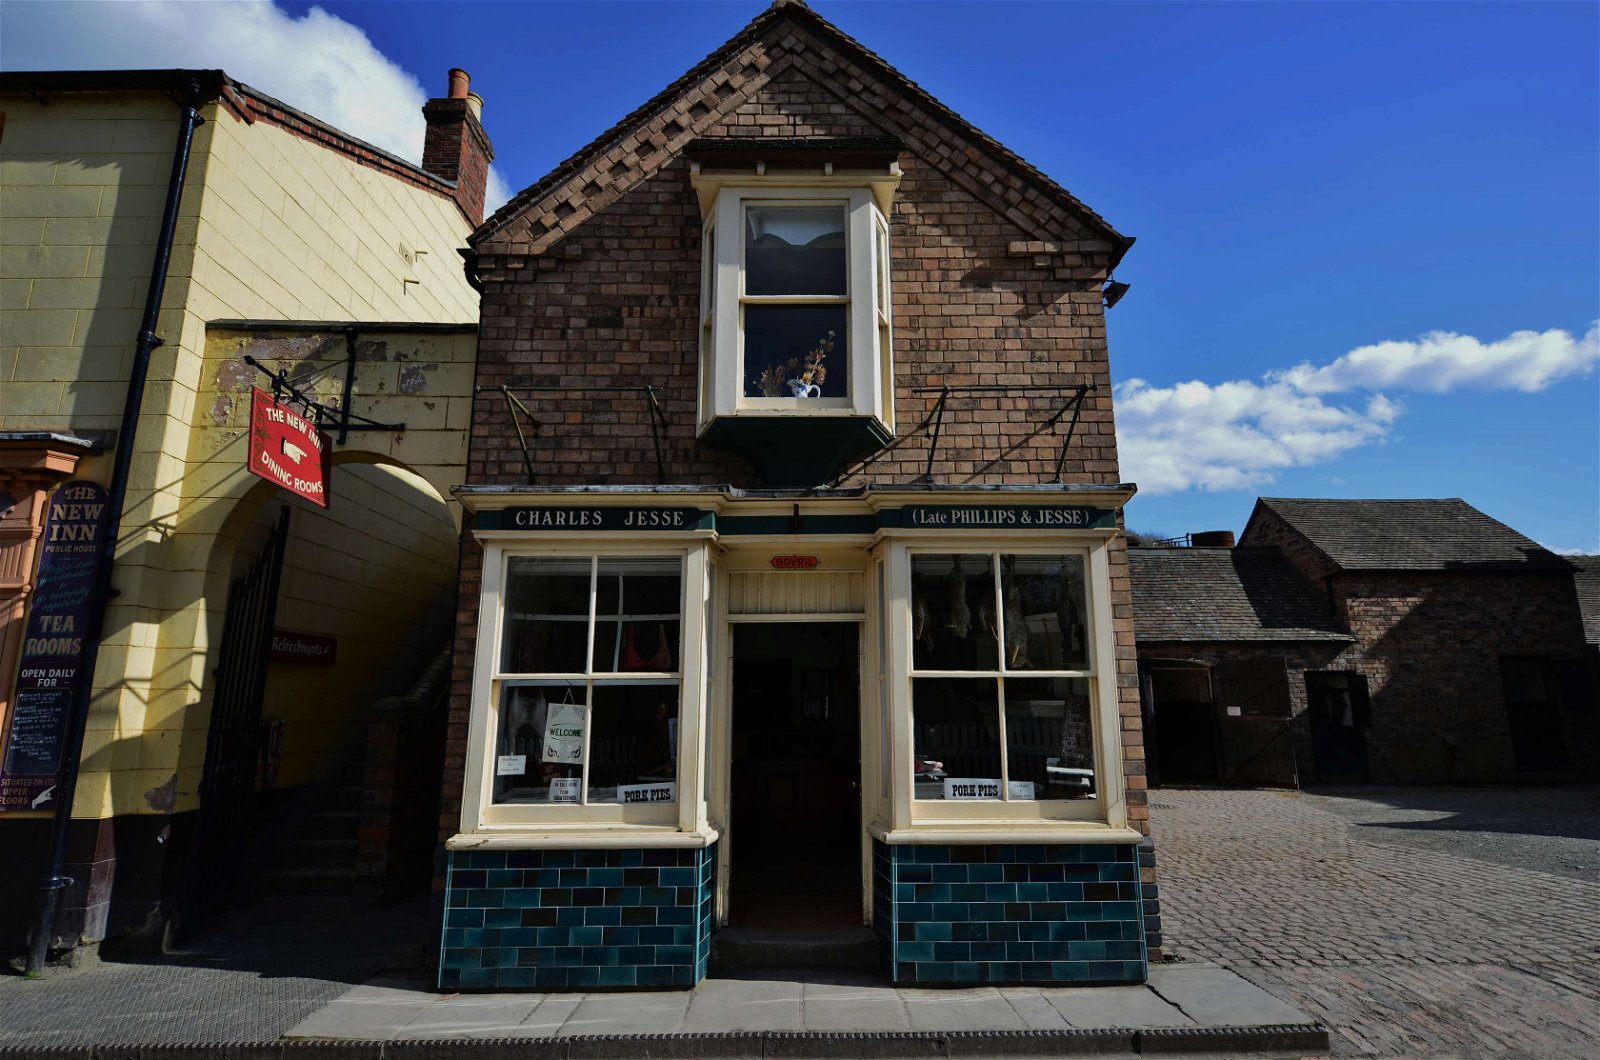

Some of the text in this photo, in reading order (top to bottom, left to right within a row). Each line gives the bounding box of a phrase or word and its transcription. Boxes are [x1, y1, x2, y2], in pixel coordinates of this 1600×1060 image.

[265, 407, 324, 454] THE NEW INN
[261, 450, 323, 494] DINING ROOMS
[65, 487, 96, 499] THE
[51, 504, 104, 520] NEW
[515, 510, 684, 526] CHARLES JESSE
[912, 508, 1089, 525] (Late PHILLIPS & JESSE)
[49, 525, 98, 541] INN
[45, 545, 97, 553] PUBLIC HOUSE
[775, 557, 815, 567] BOVRIL
[39, 615, 75, 633] TEA
[27, 638, 82, 656] ROOMS
[272, 637, 321, 655] Refreshments
[21, 669, 76, 678] OPEN DAILY
[37, 678, 58, 687] FOR
[549, 728, 584, 738] WELCOME
[1, 778, 32, 787] SITUATED
[34, 778, 43, 786] ON
[3, 788, 28, 796] UPPER
[624, 788, 671, 803] PORK PIES
[952, 784, 998, 797] PORK PIES
